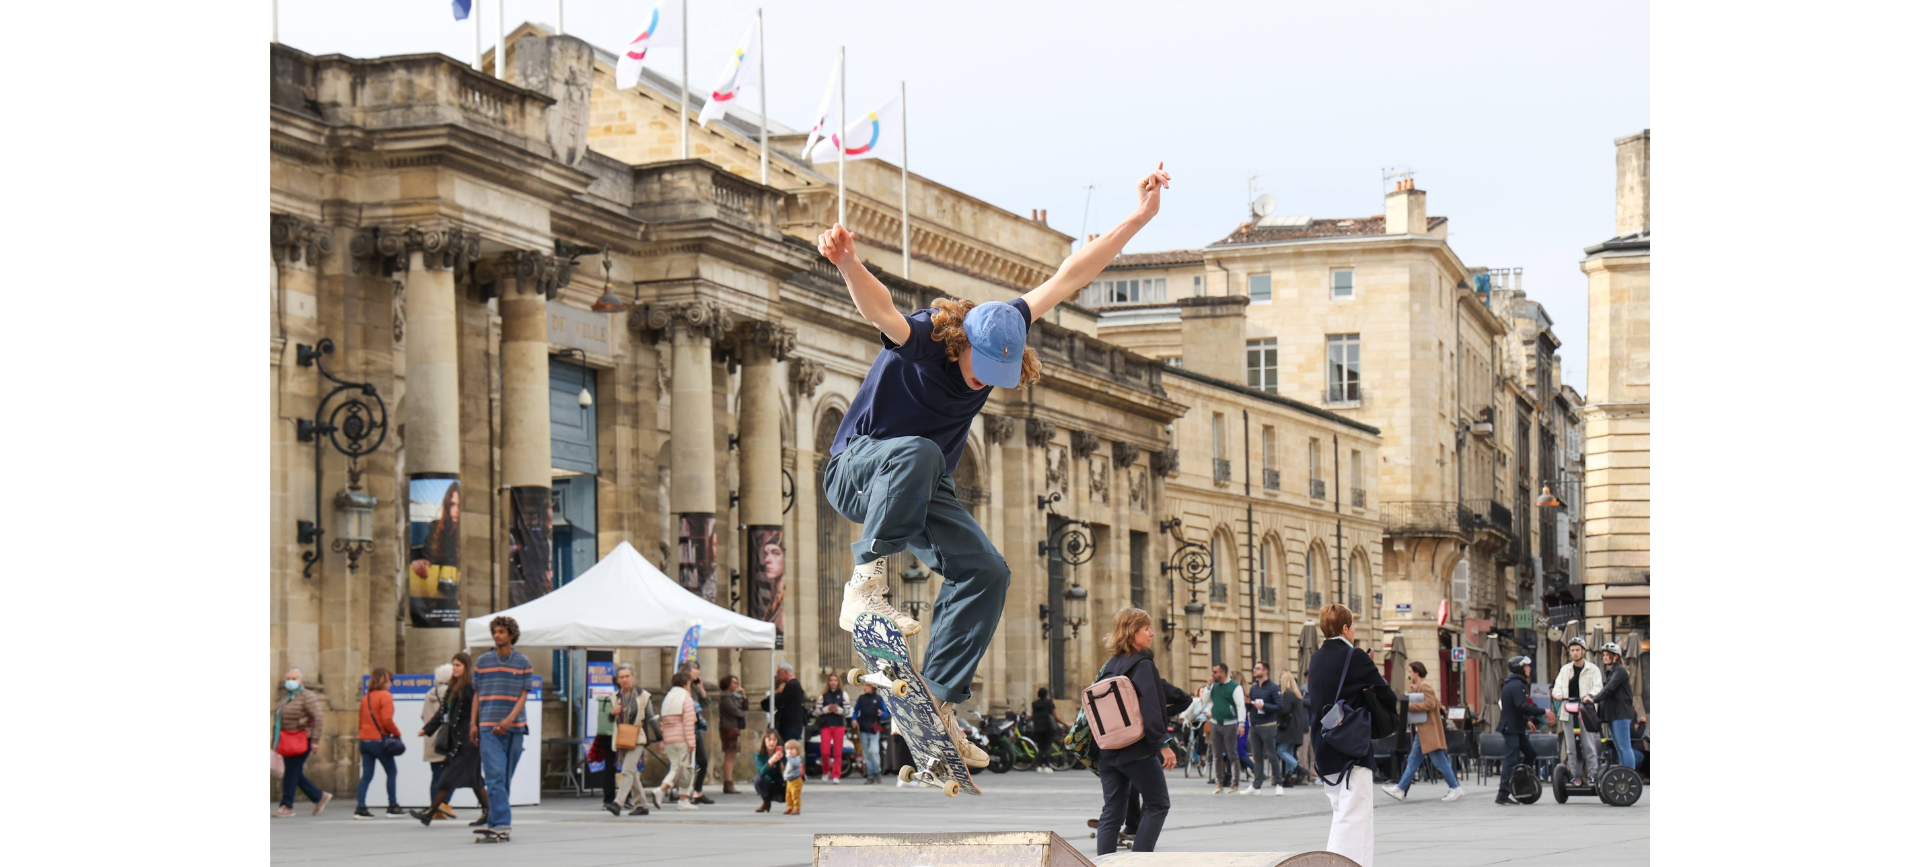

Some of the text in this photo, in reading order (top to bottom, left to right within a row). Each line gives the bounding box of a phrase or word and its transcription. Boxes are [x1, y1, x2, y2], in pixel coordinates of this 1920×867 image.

[551, 314, 608, 343] DE VILLE
[941, 746, 974, 788] HOCKEY
